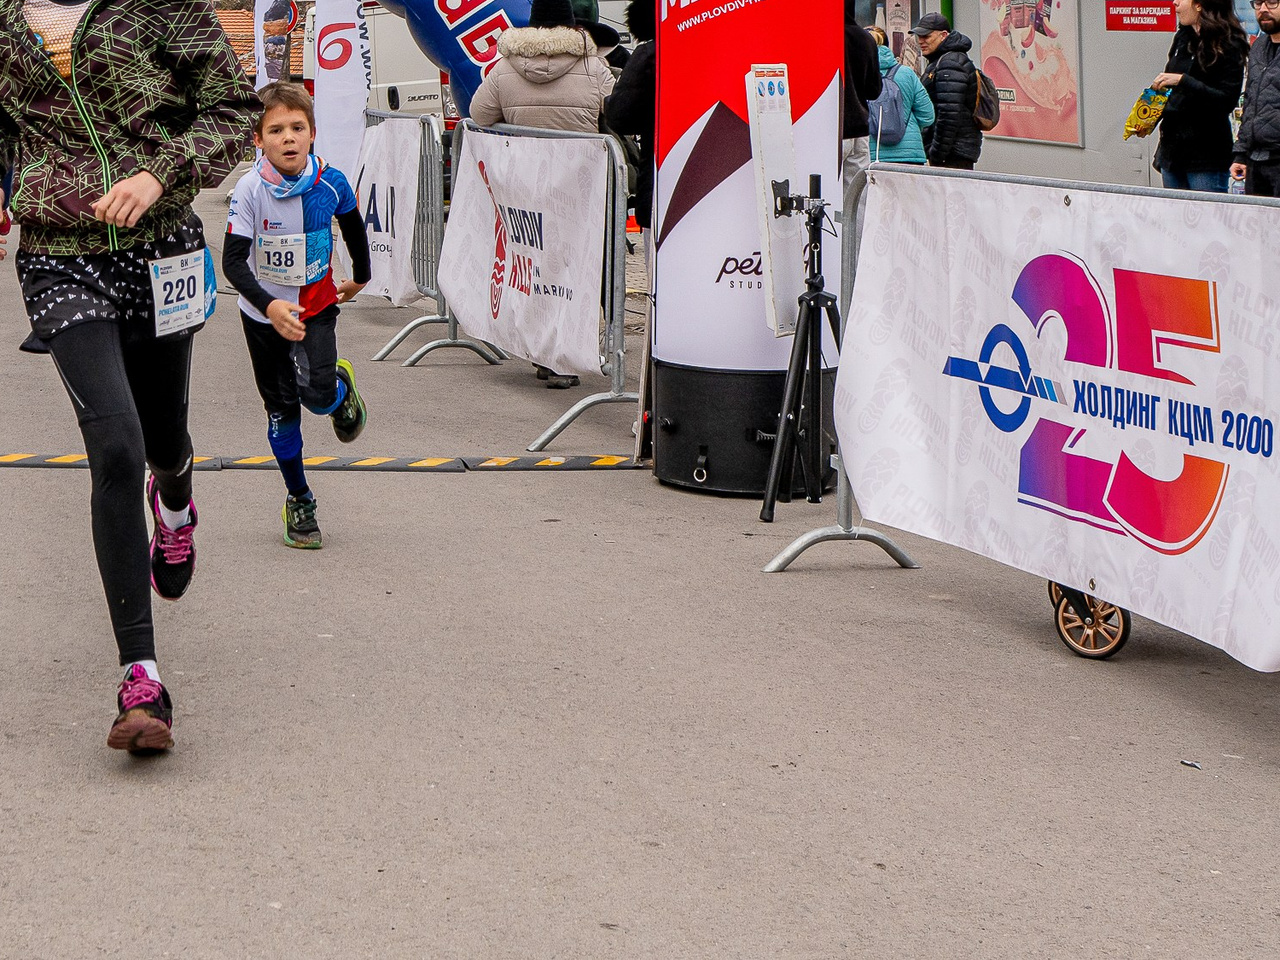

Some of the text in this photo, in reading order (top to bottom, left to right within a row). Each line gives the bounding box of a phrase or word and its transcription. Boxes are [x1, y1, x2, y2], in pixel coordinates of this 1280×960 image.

[1109, 7, 1132, 15] ПАРКИНГ
[407, 94, 439, 102] DUCATO
[180, 258, 189, 268] 8K
[264, 250, 294, 268] 138
[163, 275, 196, 305] 220
[1072, 379, 1274, 458] ХОЛДИНГ КЦМ 2000
